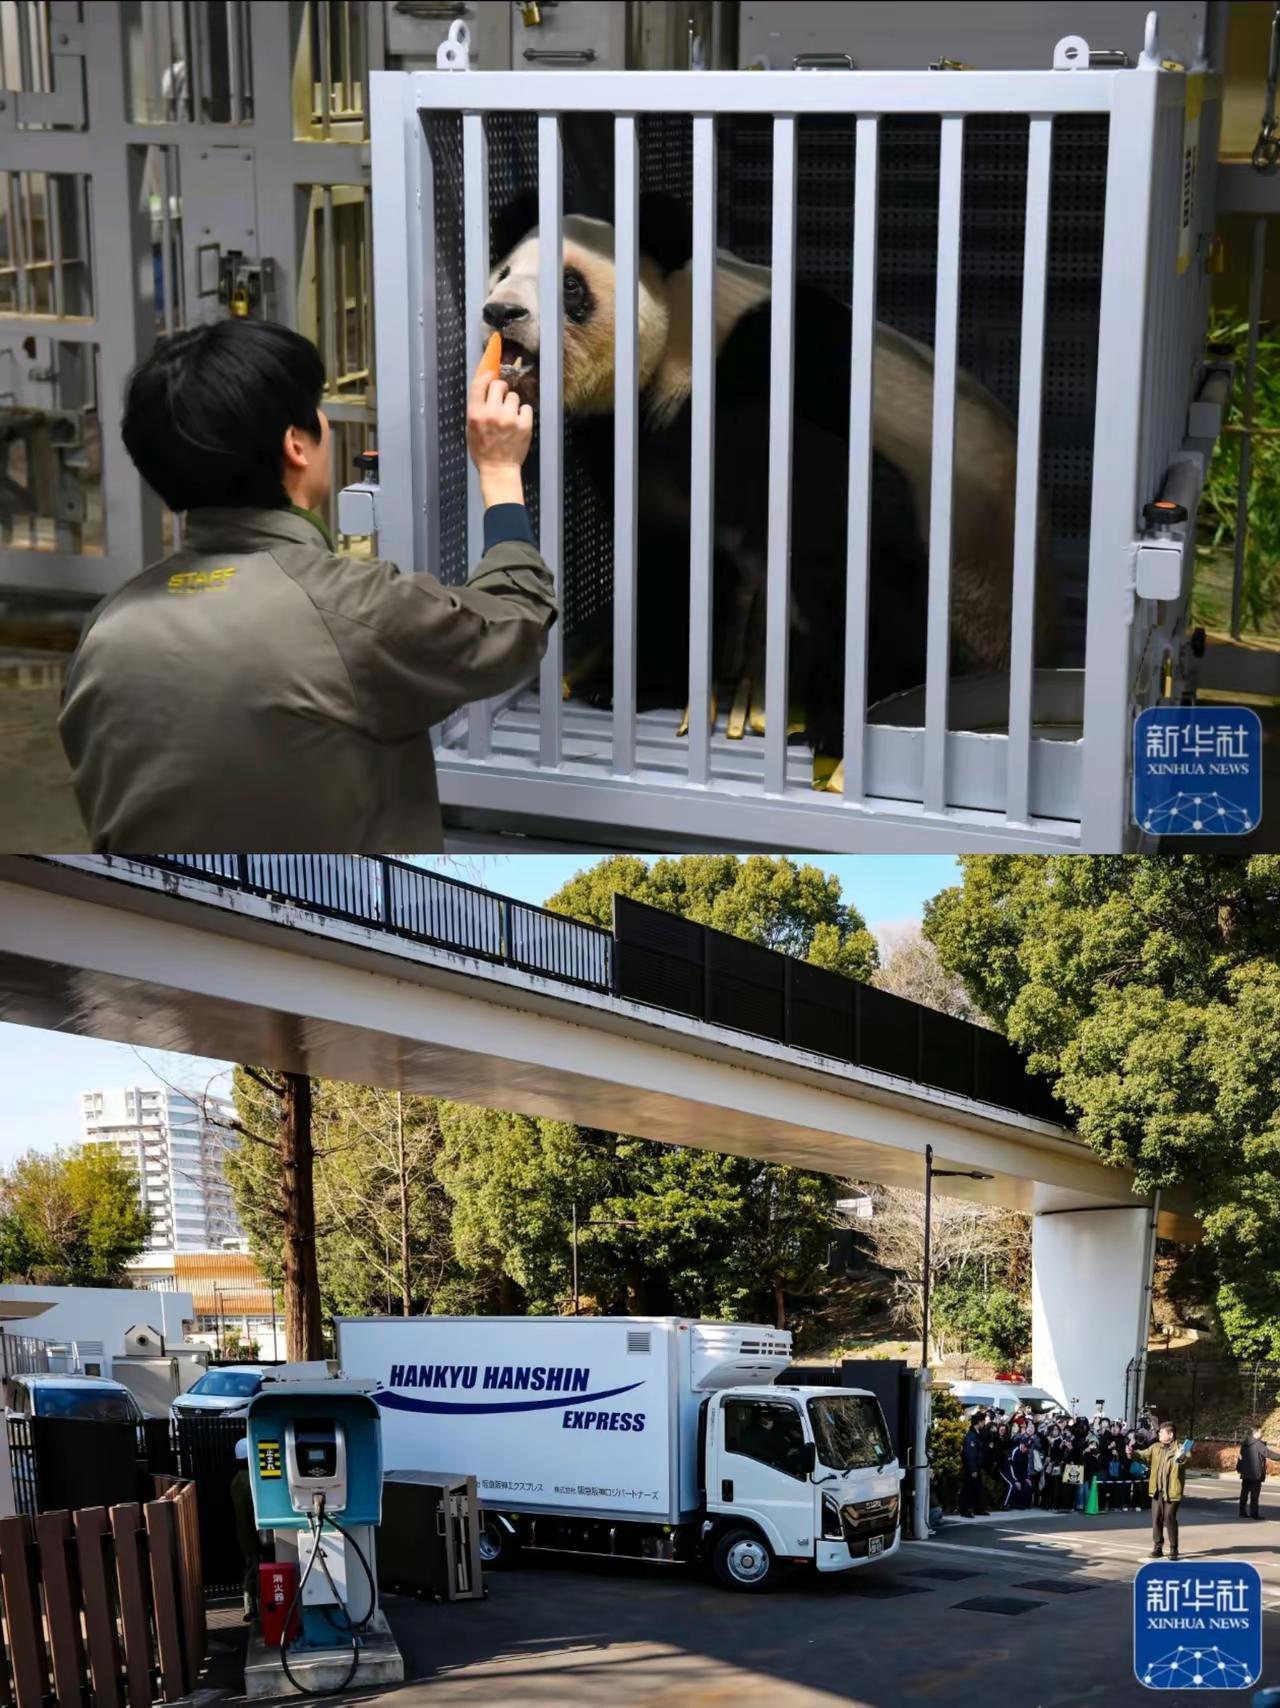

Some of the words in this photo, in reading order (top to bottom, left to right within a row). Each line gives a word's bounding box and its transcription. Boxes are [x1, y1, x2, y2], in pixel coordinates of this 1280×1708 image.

[389, 1364, 478, 1389] HANKYU
[482, 1366, 590, 1392] HANSHIN
[562, 1410, 646, 1432] EXPRESS
